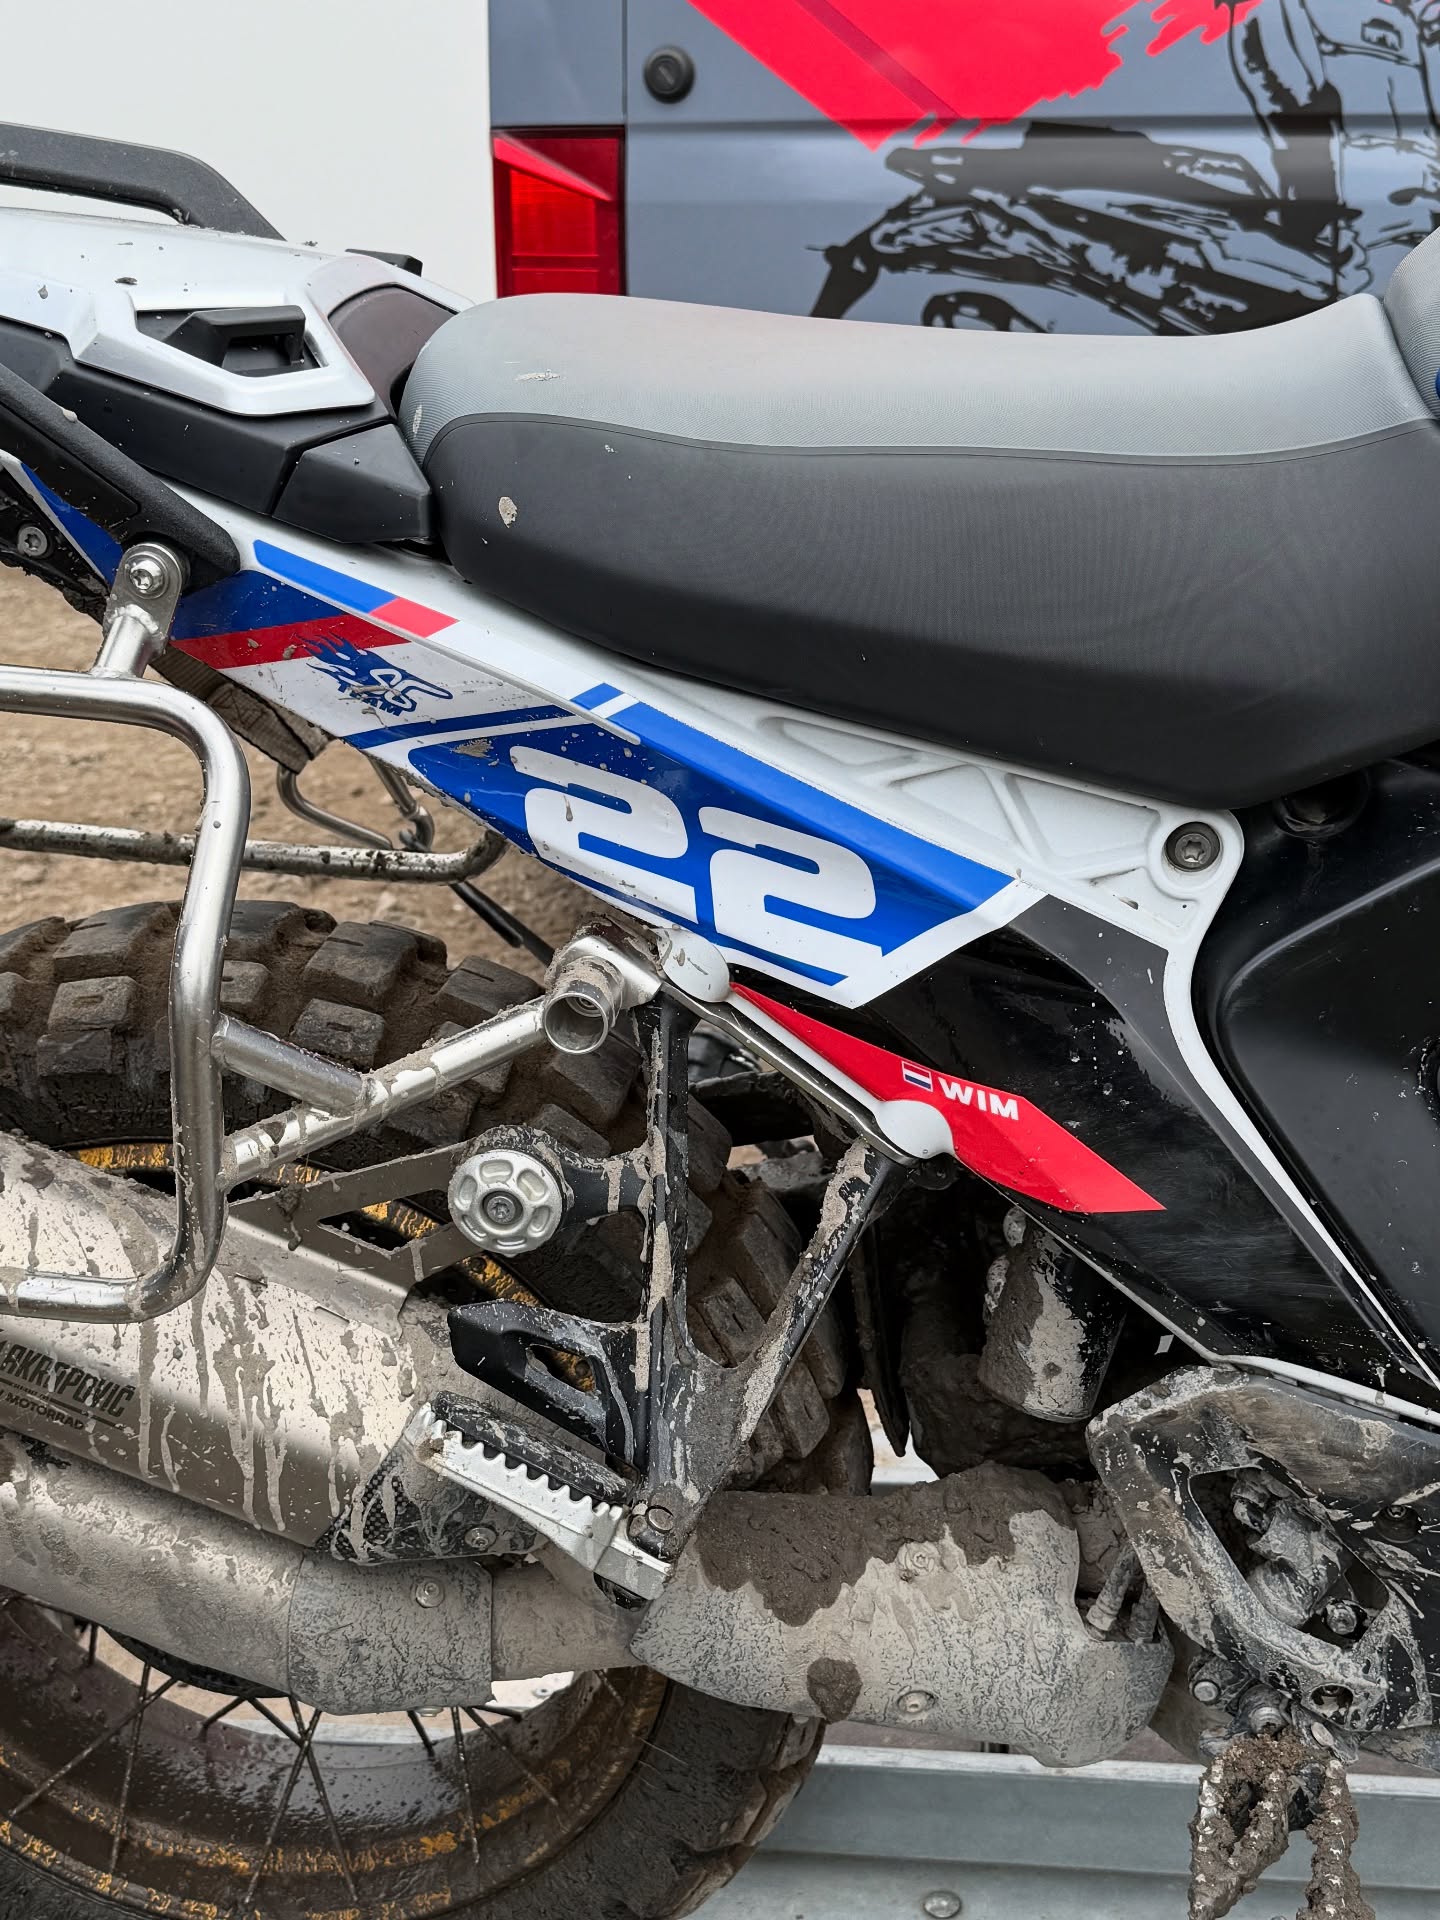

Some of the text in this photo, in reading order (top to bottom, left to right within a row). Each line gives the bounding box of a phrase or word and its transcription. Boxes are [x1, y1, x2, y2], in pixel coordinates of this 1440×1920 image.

[509, 745, 887, 986] 22
[938, 1076, 1019, 1121] WIM
[5, 1392, 84, 1430] MOTORRAD
